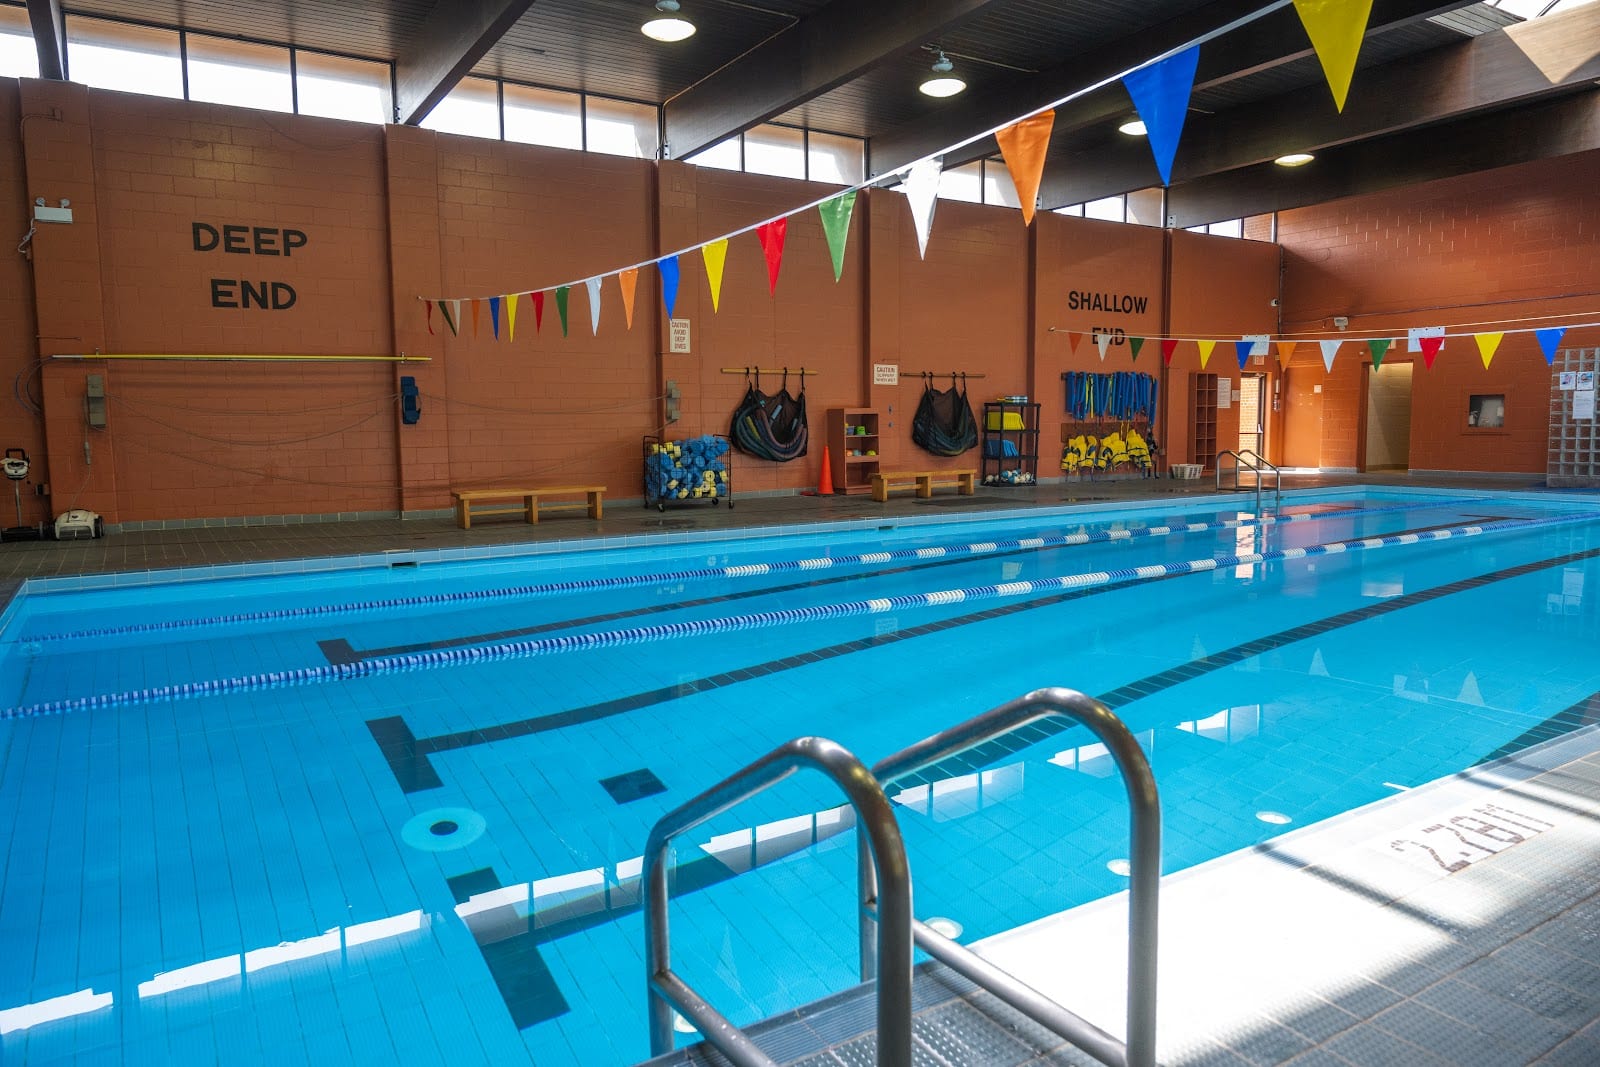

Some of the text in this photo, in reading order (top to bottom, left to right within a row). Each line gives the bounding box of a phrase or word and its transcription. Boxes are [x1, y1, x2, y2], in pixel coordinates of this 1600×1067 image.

[192, 222, 308, 257] DEEP
[211, 279, 297, 310] END
[1068, 290, 1148, 314] SHALLOW
[1092, 327, 1126, 346] END
